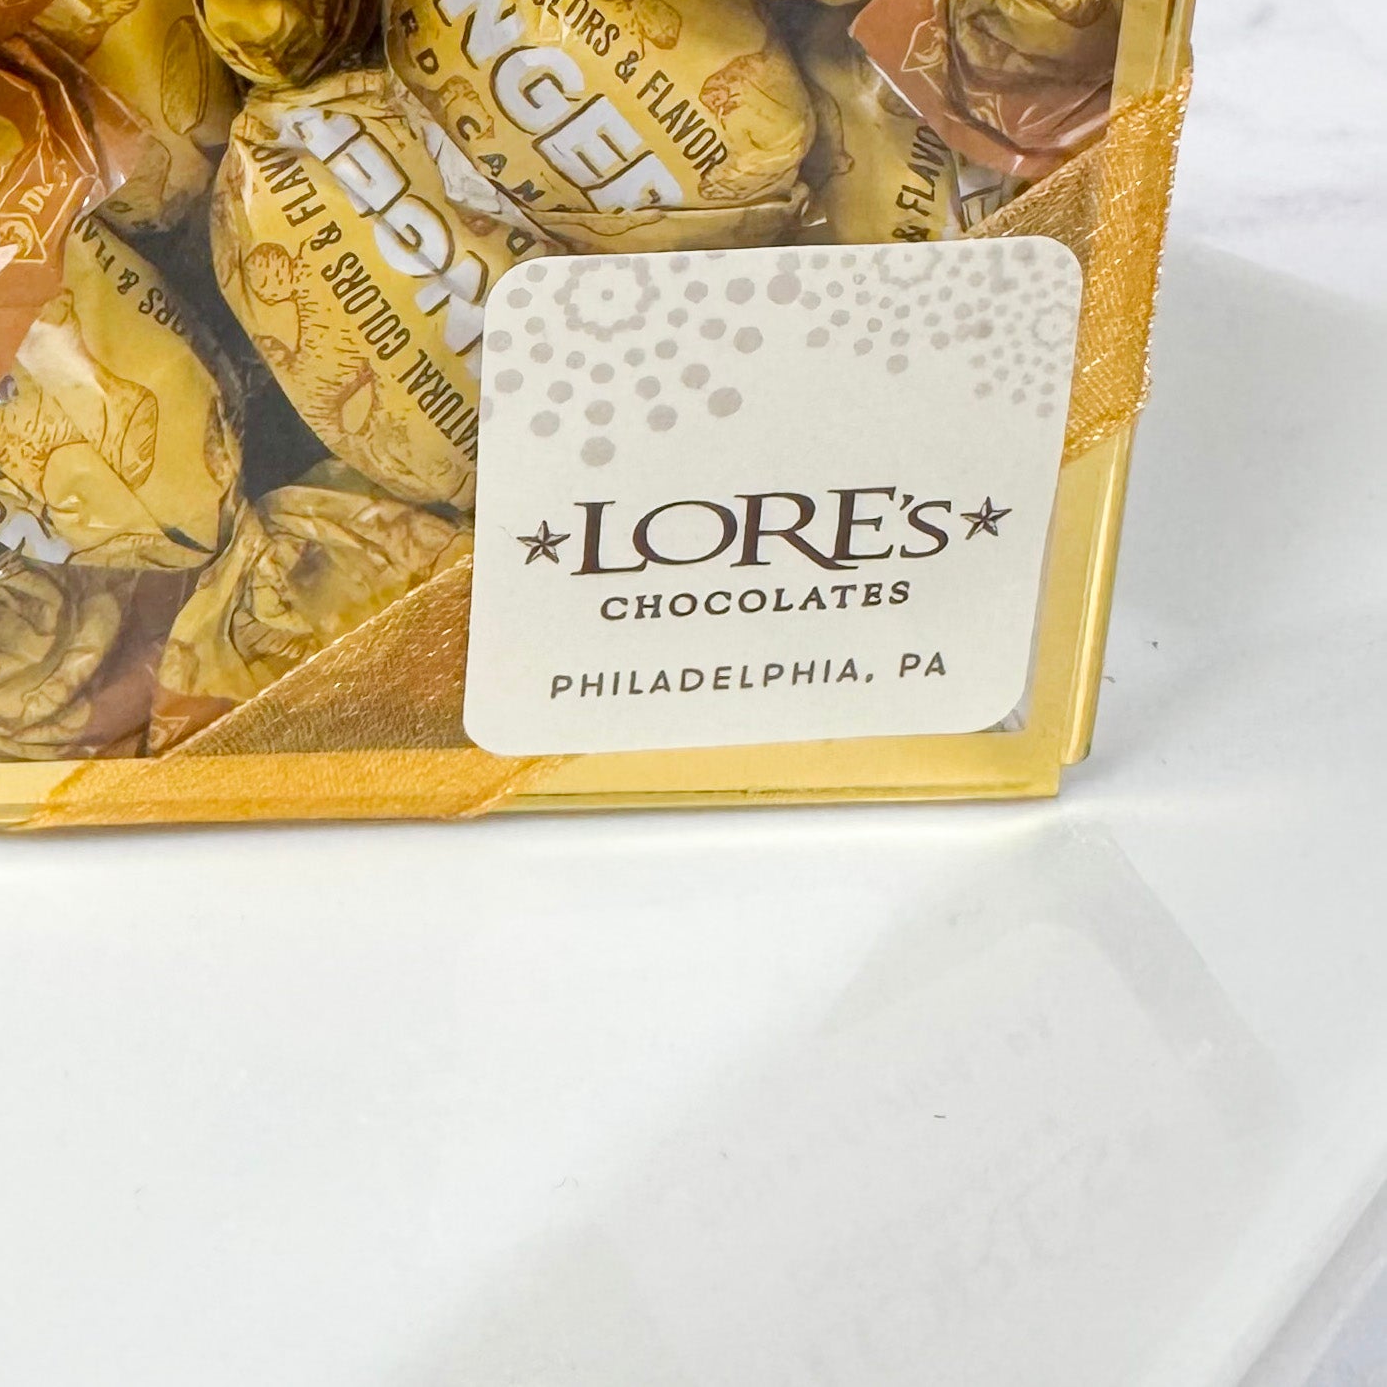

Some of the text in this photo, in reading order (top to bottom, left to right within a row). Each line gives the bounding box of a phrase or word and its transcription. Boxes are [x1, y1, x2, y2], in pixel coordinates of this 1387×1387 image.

[455, 114, 546, 202] CAN
[614, 49, 640, 84] &
[636, 69, 729, 180] FLAVOR
[896, 124, 950, 220] FLAVO
[308, 220, 342, 253] &
[319, 245, 407, 358] COLORS
[600, 580, 912, 622] CHOCOLATES
[550, 651, 947, 700] PHILADELPHIA, PA
